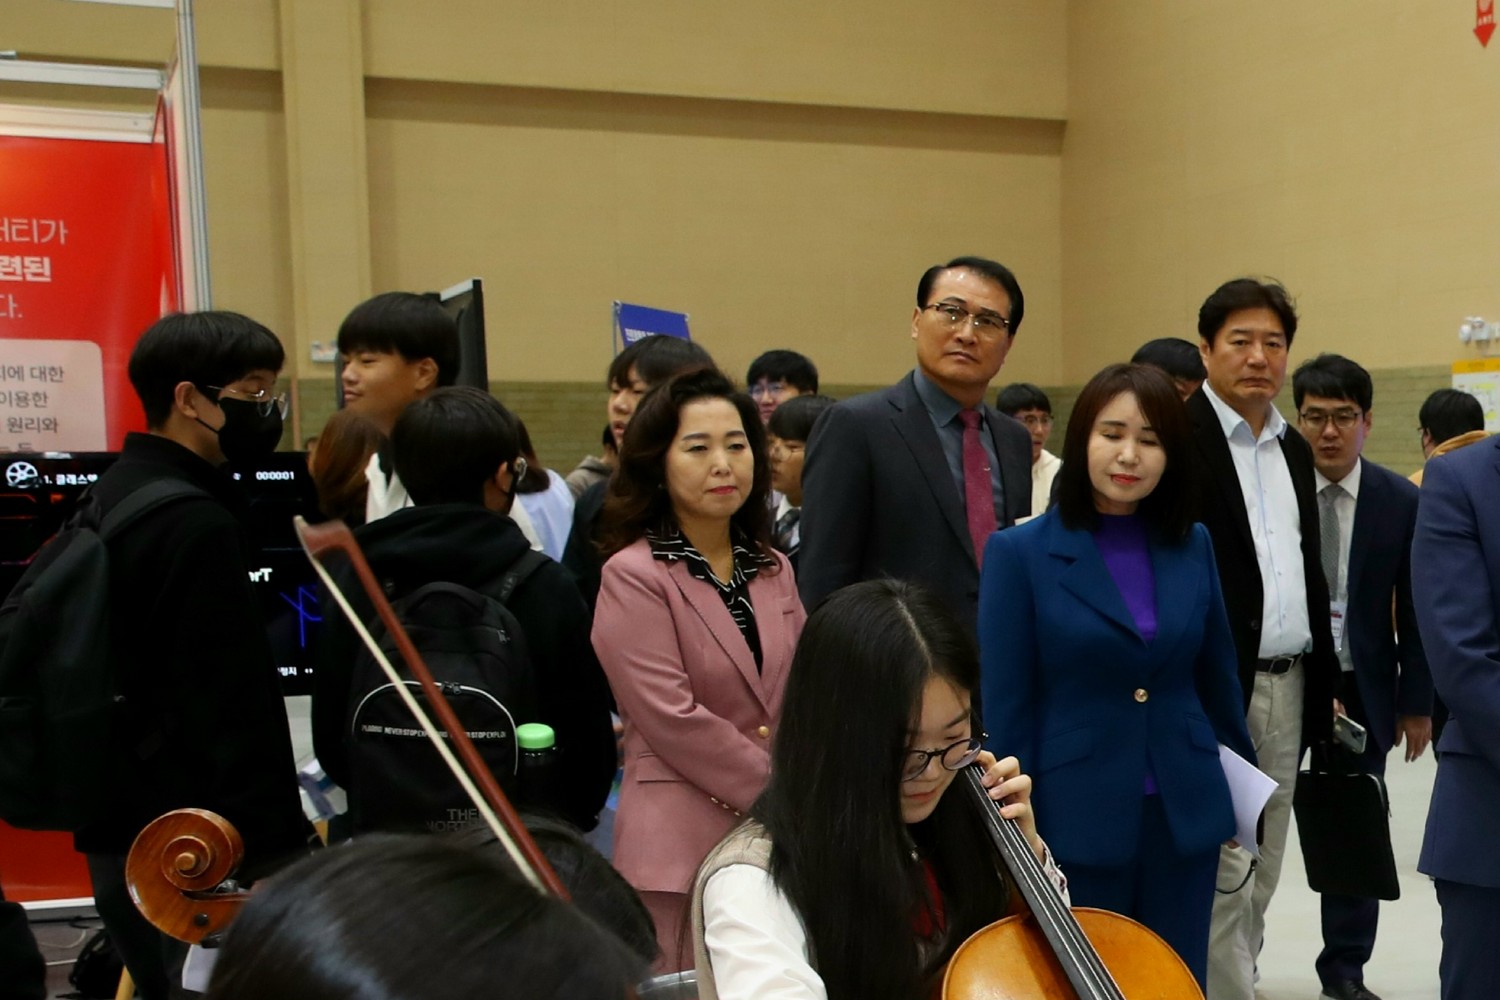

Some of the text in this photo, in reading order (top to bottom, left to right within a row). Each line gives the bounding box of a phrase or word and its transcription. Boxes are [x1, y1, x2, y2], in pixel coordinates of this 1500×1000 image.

[30, 365, 65, 384] 대한
[7, 416, 59, 434] 원리와
[446, 807, 477, 821] THE
